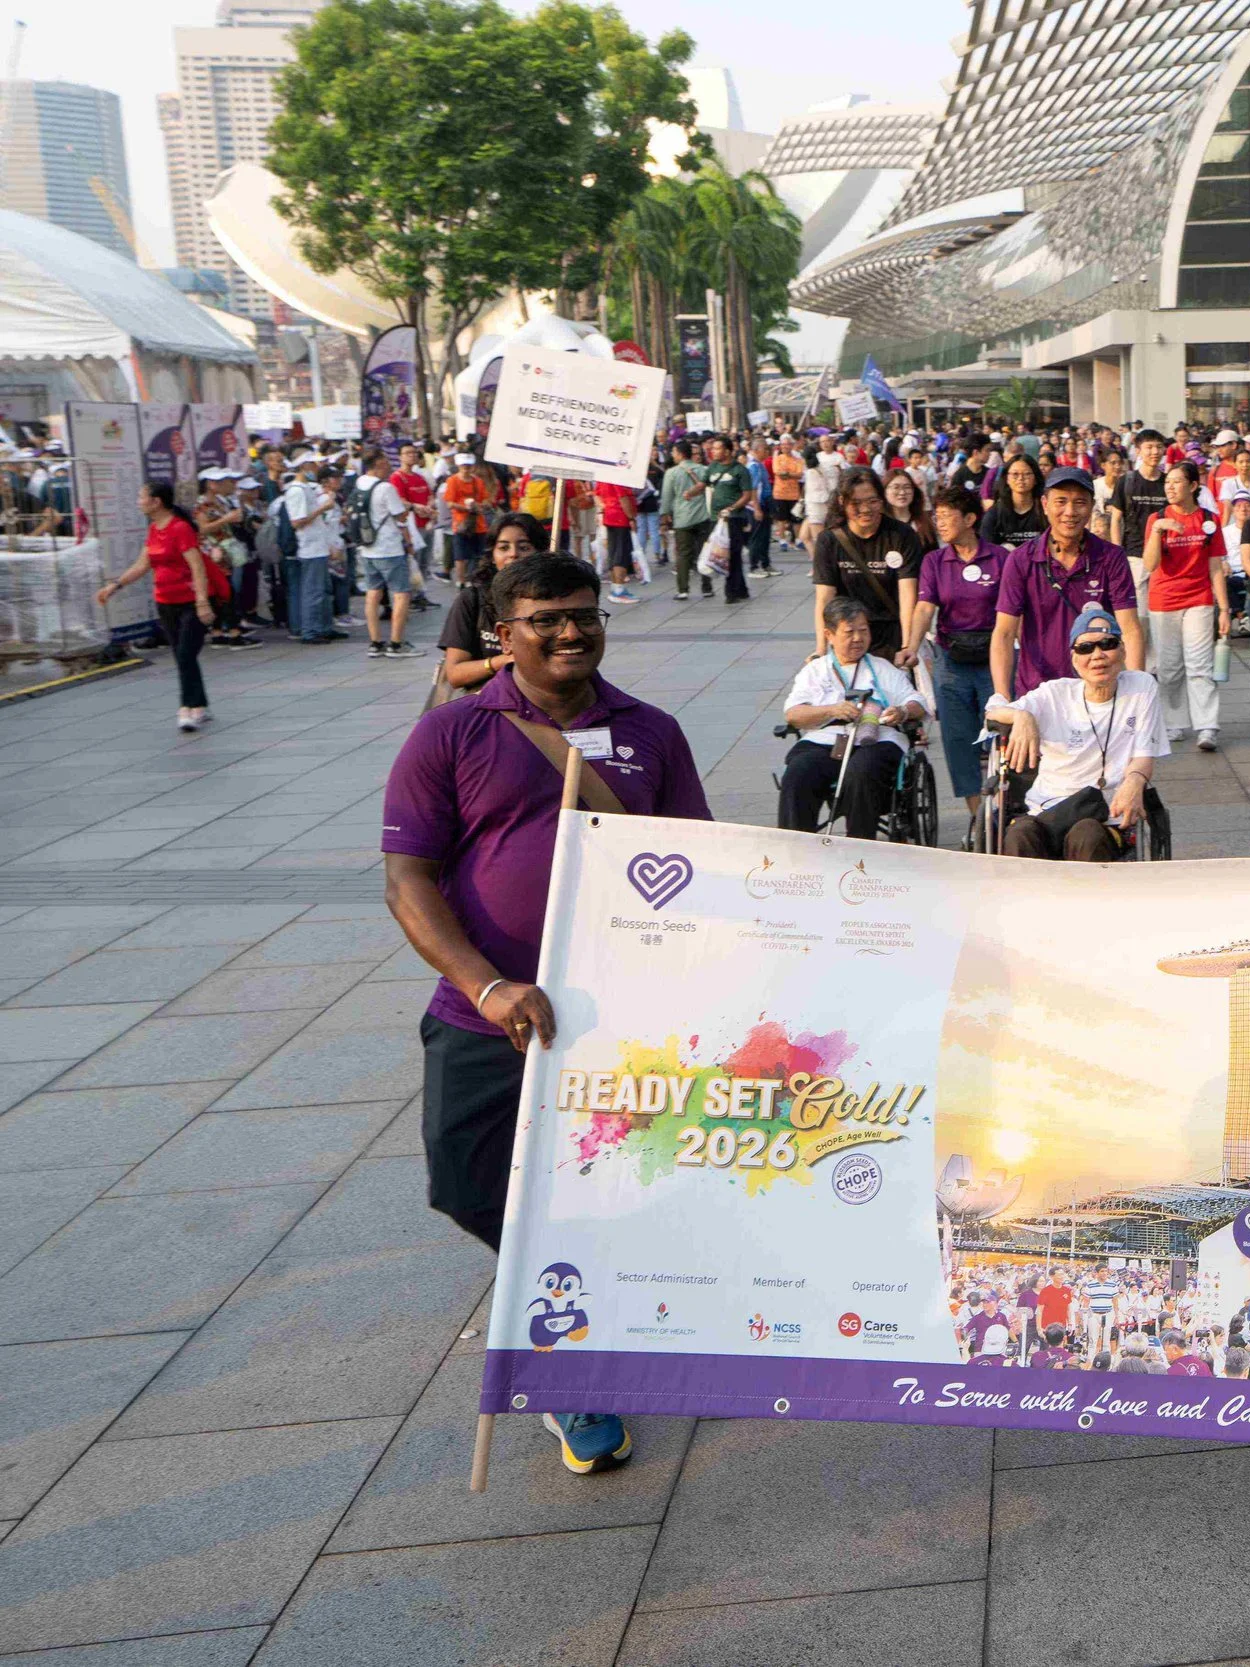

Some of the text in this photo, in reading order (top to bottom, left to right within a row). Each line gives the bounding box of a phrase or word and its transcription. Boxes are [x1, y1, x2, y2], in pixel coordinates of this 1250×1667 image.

[530, 392, 619, 417] BEFRIENDING
[517, 406, 634, 436] MEDICAL ESCORT
[544, 427, 602, 446] SERVICE
[789, 873, 824, 881] CHARITY
[752, 879, 824, 889] TRANSPARENCY
[848, 883, 912, 893] TRANSPARENCY
[610, 916, 697, 932] Blossom Seeds
[870, 922, 912, 930] ASSOCIATION
[845, 929, 884, 938] COMMUNITY
[556, 1069, 926, 1130] READY SET Gold!
[847, 1133, 862, 1141] Age
[674, 1124, 800, 1170] 2026
[836, 1168, 878, 1191] CHOPE
[616, 1272, 718, 1285] Sector Administrator
[753, 1277, 806, 1289] Member of
[852, 1281, 908, 1292] Operator of
[626, 1327, 659, 1335] MINISTRY
[773, 1323, 801, 1333] NCSS
[840, 1319, 899, 1332] SG Cares
[893, 1377, 926, 1406] To
[934, 1382, 1010, 1409] Serve
[1020, 1386, 1076, 1412] with
[1080, 1387, 1147, 1416] Love
[1157, 1396, 1210, 1420] and
